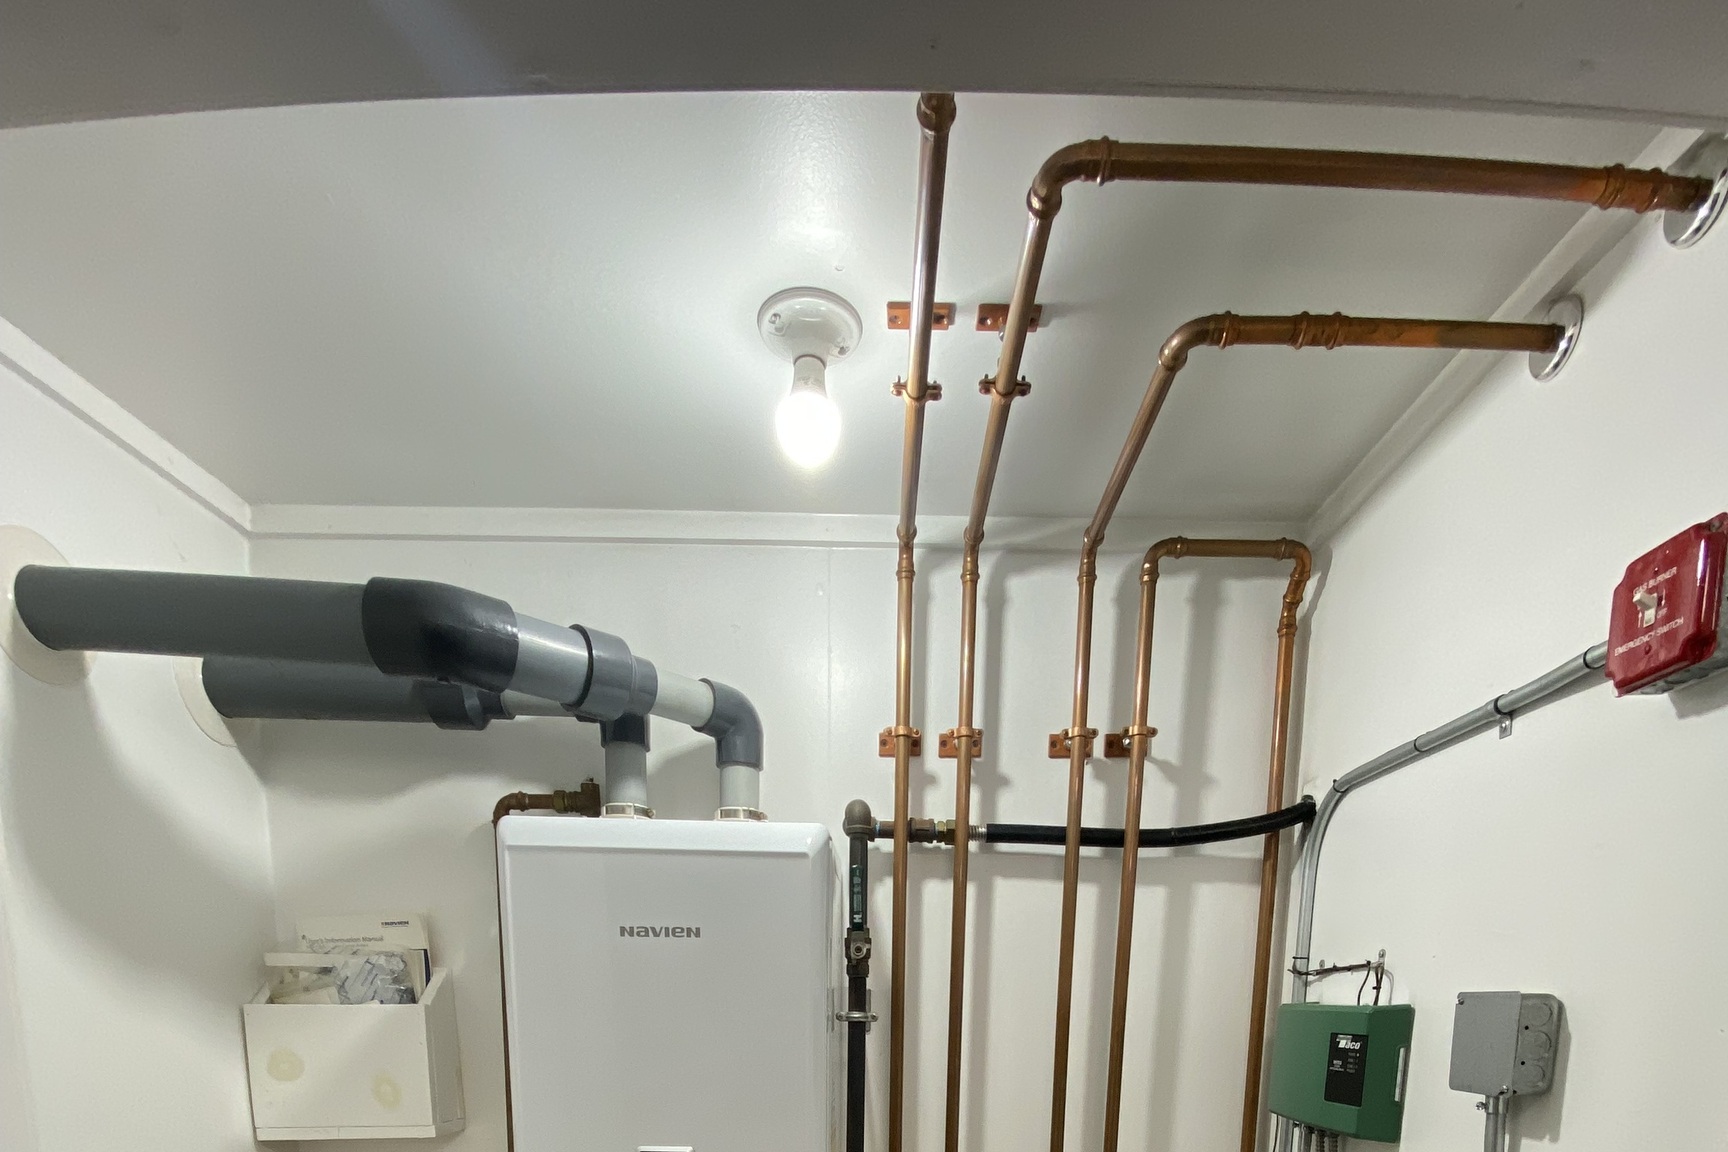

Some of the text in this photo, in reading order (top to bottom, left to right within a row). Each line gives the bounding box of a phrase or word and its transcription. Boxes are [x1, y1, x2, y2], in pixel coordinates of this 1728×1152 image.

[1633, 567, 1677, 596] GAS BURNER
[1615, 616, 1684, 657] EMERGENCY SWITCH
